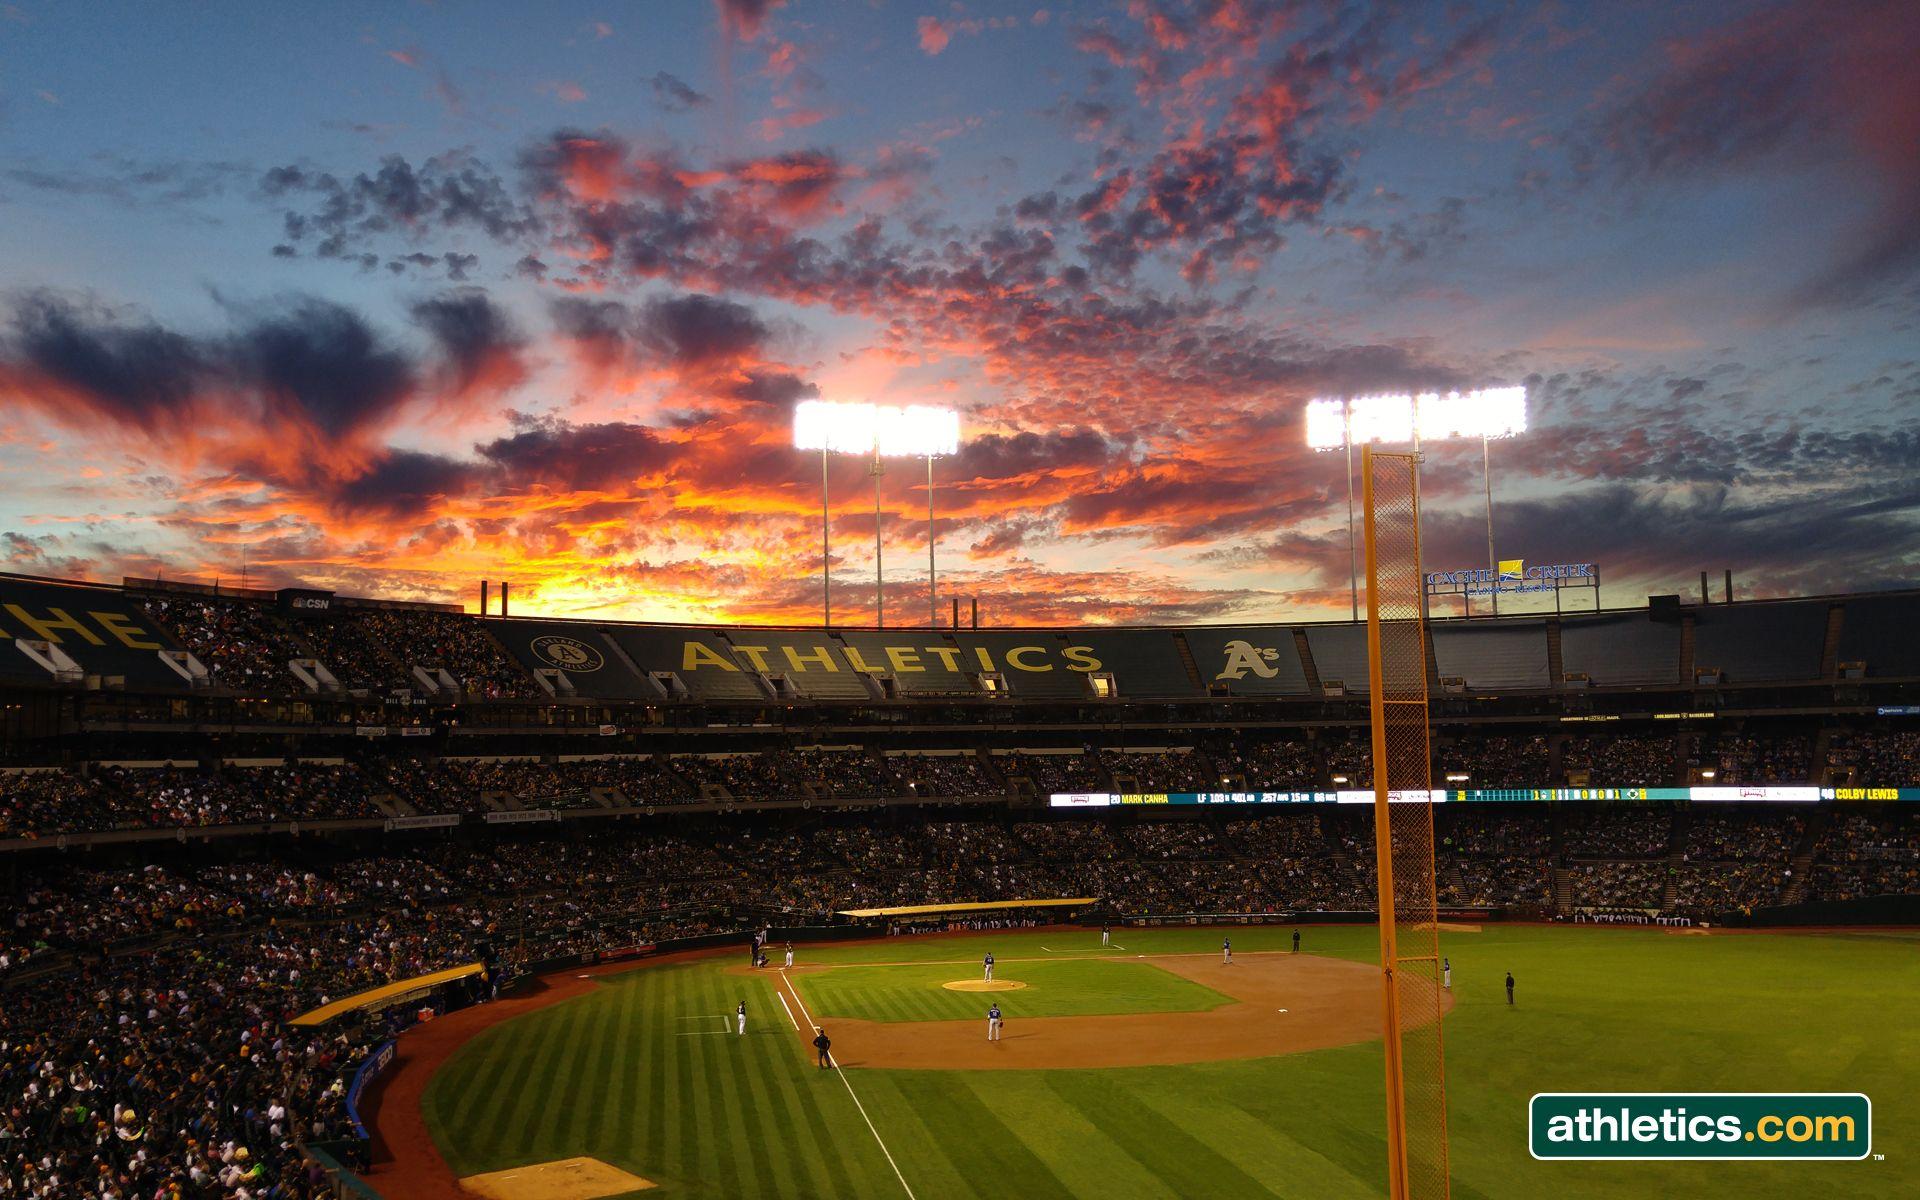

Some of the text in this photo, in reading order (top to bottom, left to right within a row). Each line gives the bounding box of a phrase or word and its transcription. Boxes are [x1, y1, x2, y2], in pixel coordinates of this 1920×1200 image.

[1428, 564, 1594, 585] CACHE CREEK
[306, 598, 330, 609] CSN
[0, 603, 163, 650] HE
[682, 640, 1104, 674] ATHLETICS
[1121, 794, 1143, 804] MARK
[1144, 794, 1169, 804] CANHA
[1197, 793, 1207, 803] LF
[1836, 788, 1866, 800] COLBY
[1867, 788, 1898, 800] LEWIS
